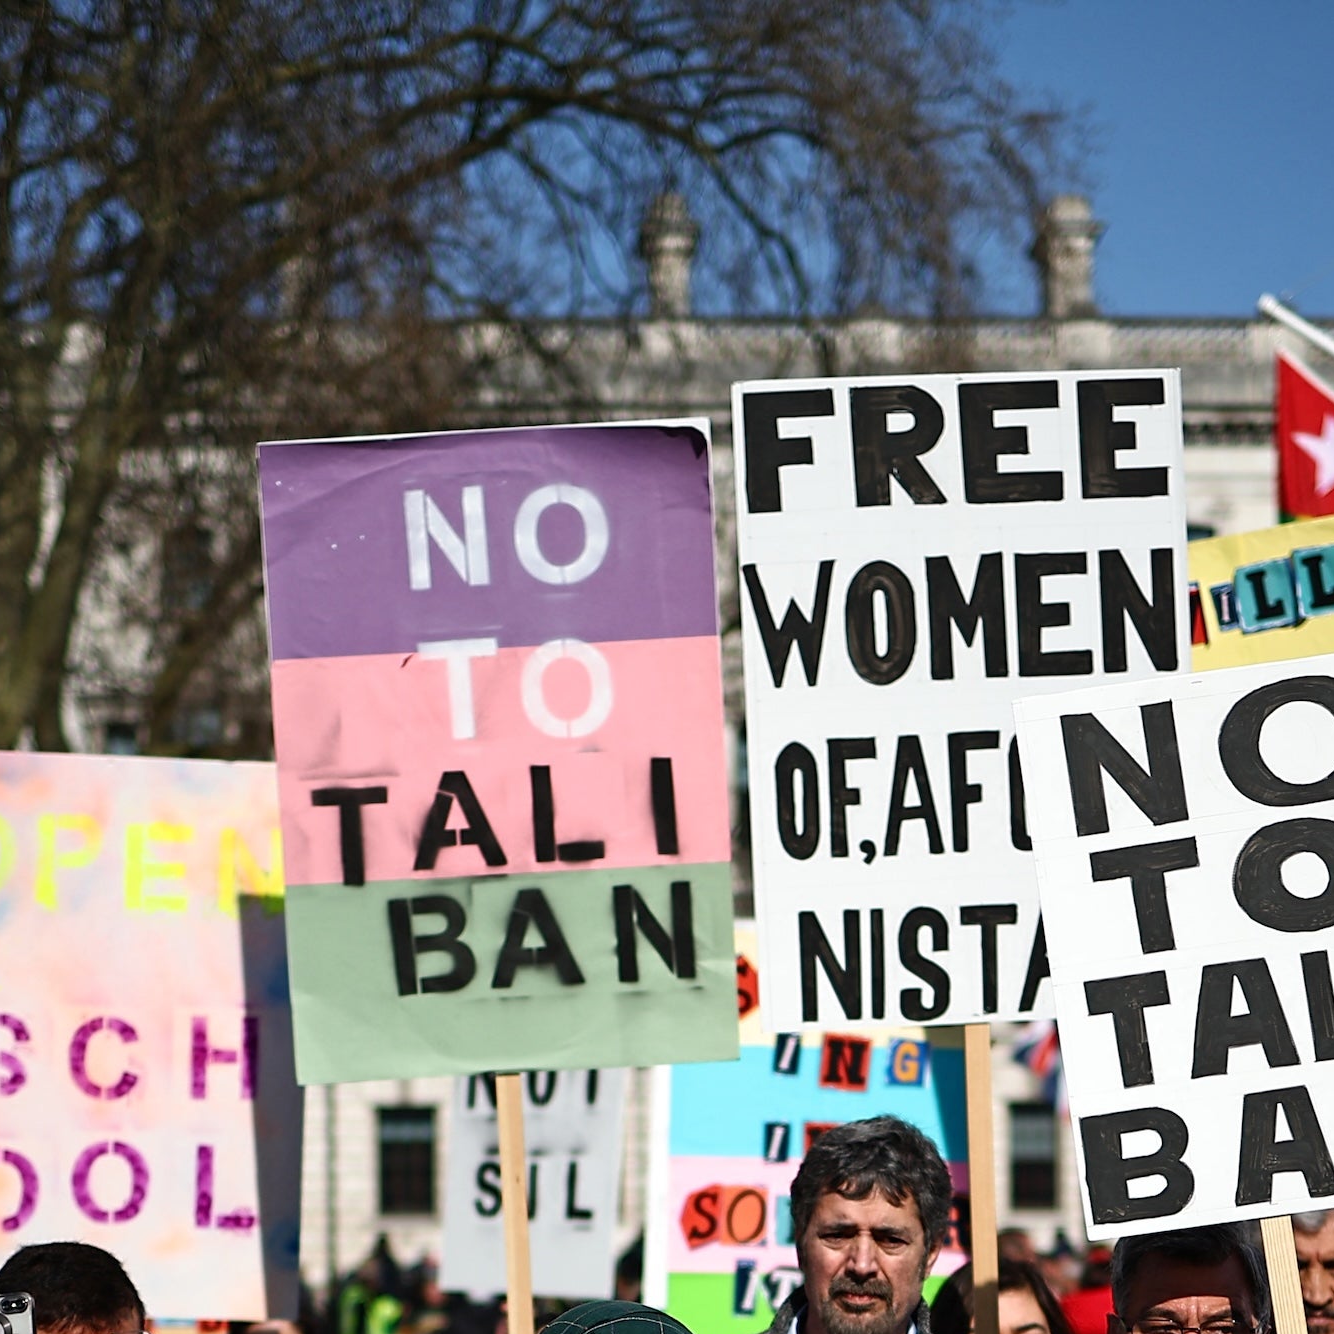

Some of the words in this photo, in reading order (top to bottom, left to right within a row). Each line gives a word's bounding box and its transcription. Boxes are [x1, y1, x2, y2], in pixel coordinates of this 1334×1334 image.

[744, 378, 1169, 512] FREE
[404, 484, 609, 590] NO
[742, 549, 1178, 688] WOMEN
[417, 637, 614, 740] TO
[311, 757, 679, 886] TALI
[387, 881, 696, 996] BAN
[779, 1034, 920, 1086] ING
